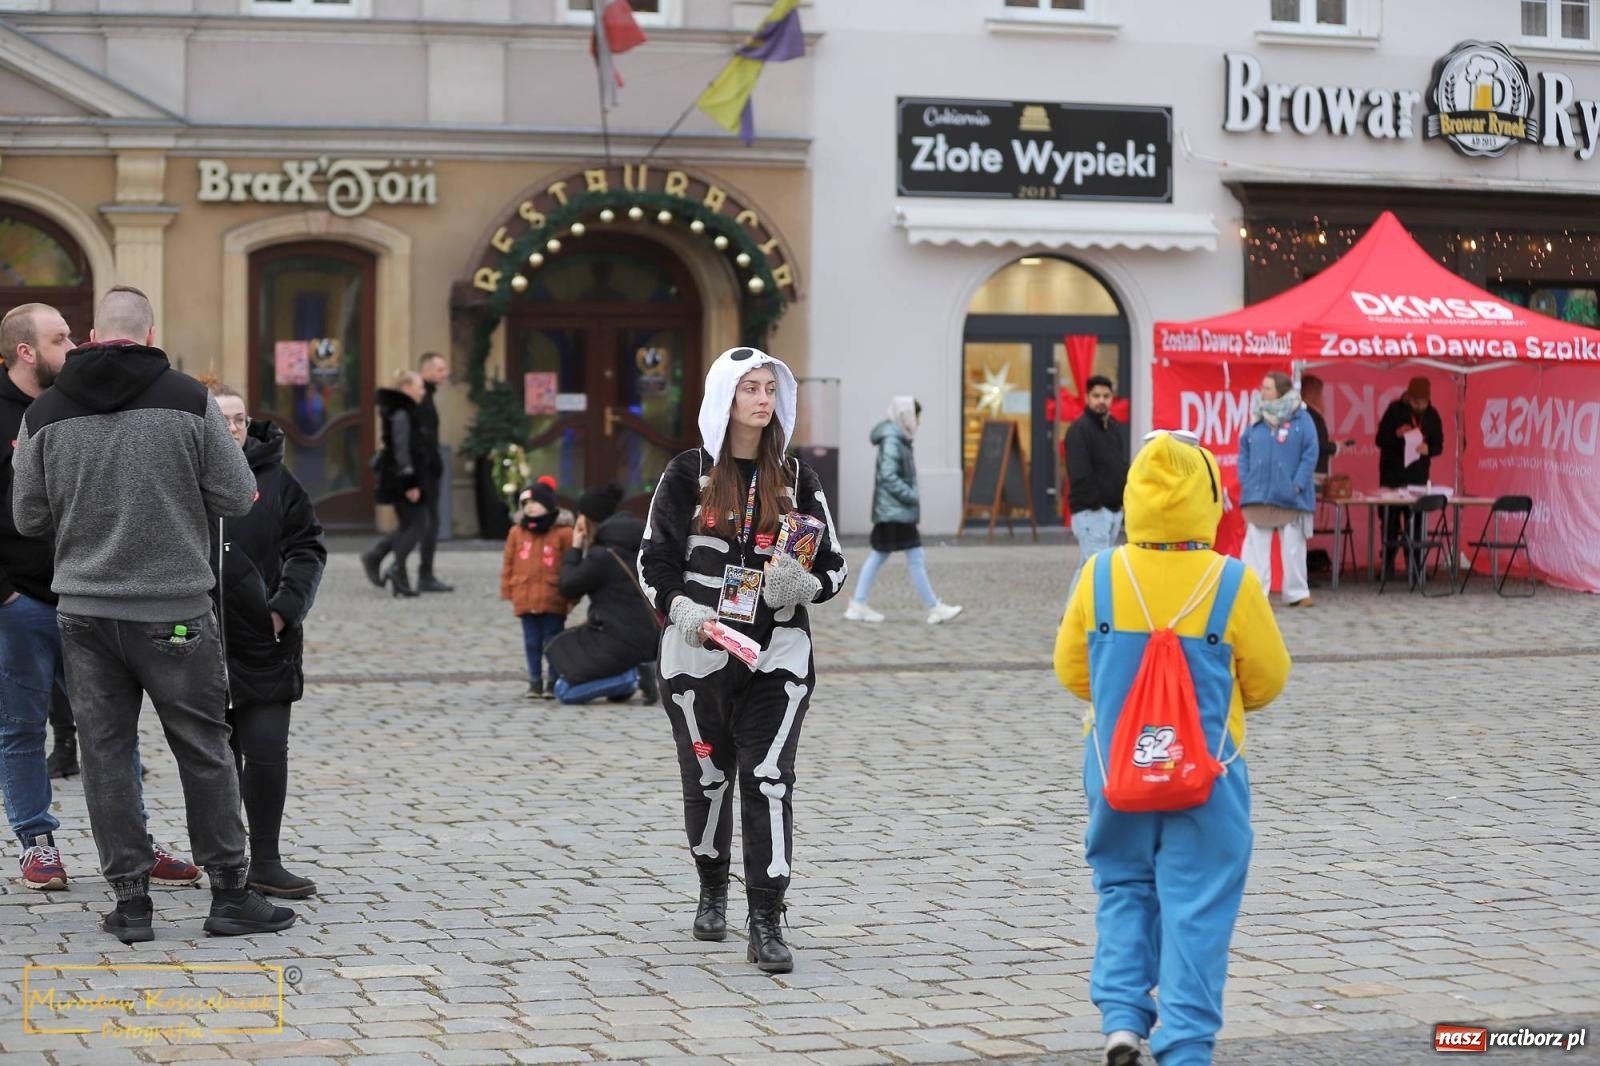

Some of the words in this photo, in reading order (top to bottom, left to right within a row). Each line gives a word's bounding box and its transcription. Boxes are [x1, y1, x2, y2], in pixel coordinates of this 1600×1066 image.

[1224, 53, 1421, 139] Browar
[1440, 112, 1487, 135] Browar
[1488, 111, 1526, 139] Rynek
[910, 133, 1004, 174] Złote
[1011, 139, 1157, 186] Wypieki
[1350, 290, 1474, 319] DKMS
[1160, 326, 1200, 352] Zostań
[1320, 332, 1418, 357] Zostań
[1525, 335, 1600, 361] Szpik
[1132, 726, 1176, 768] 32
